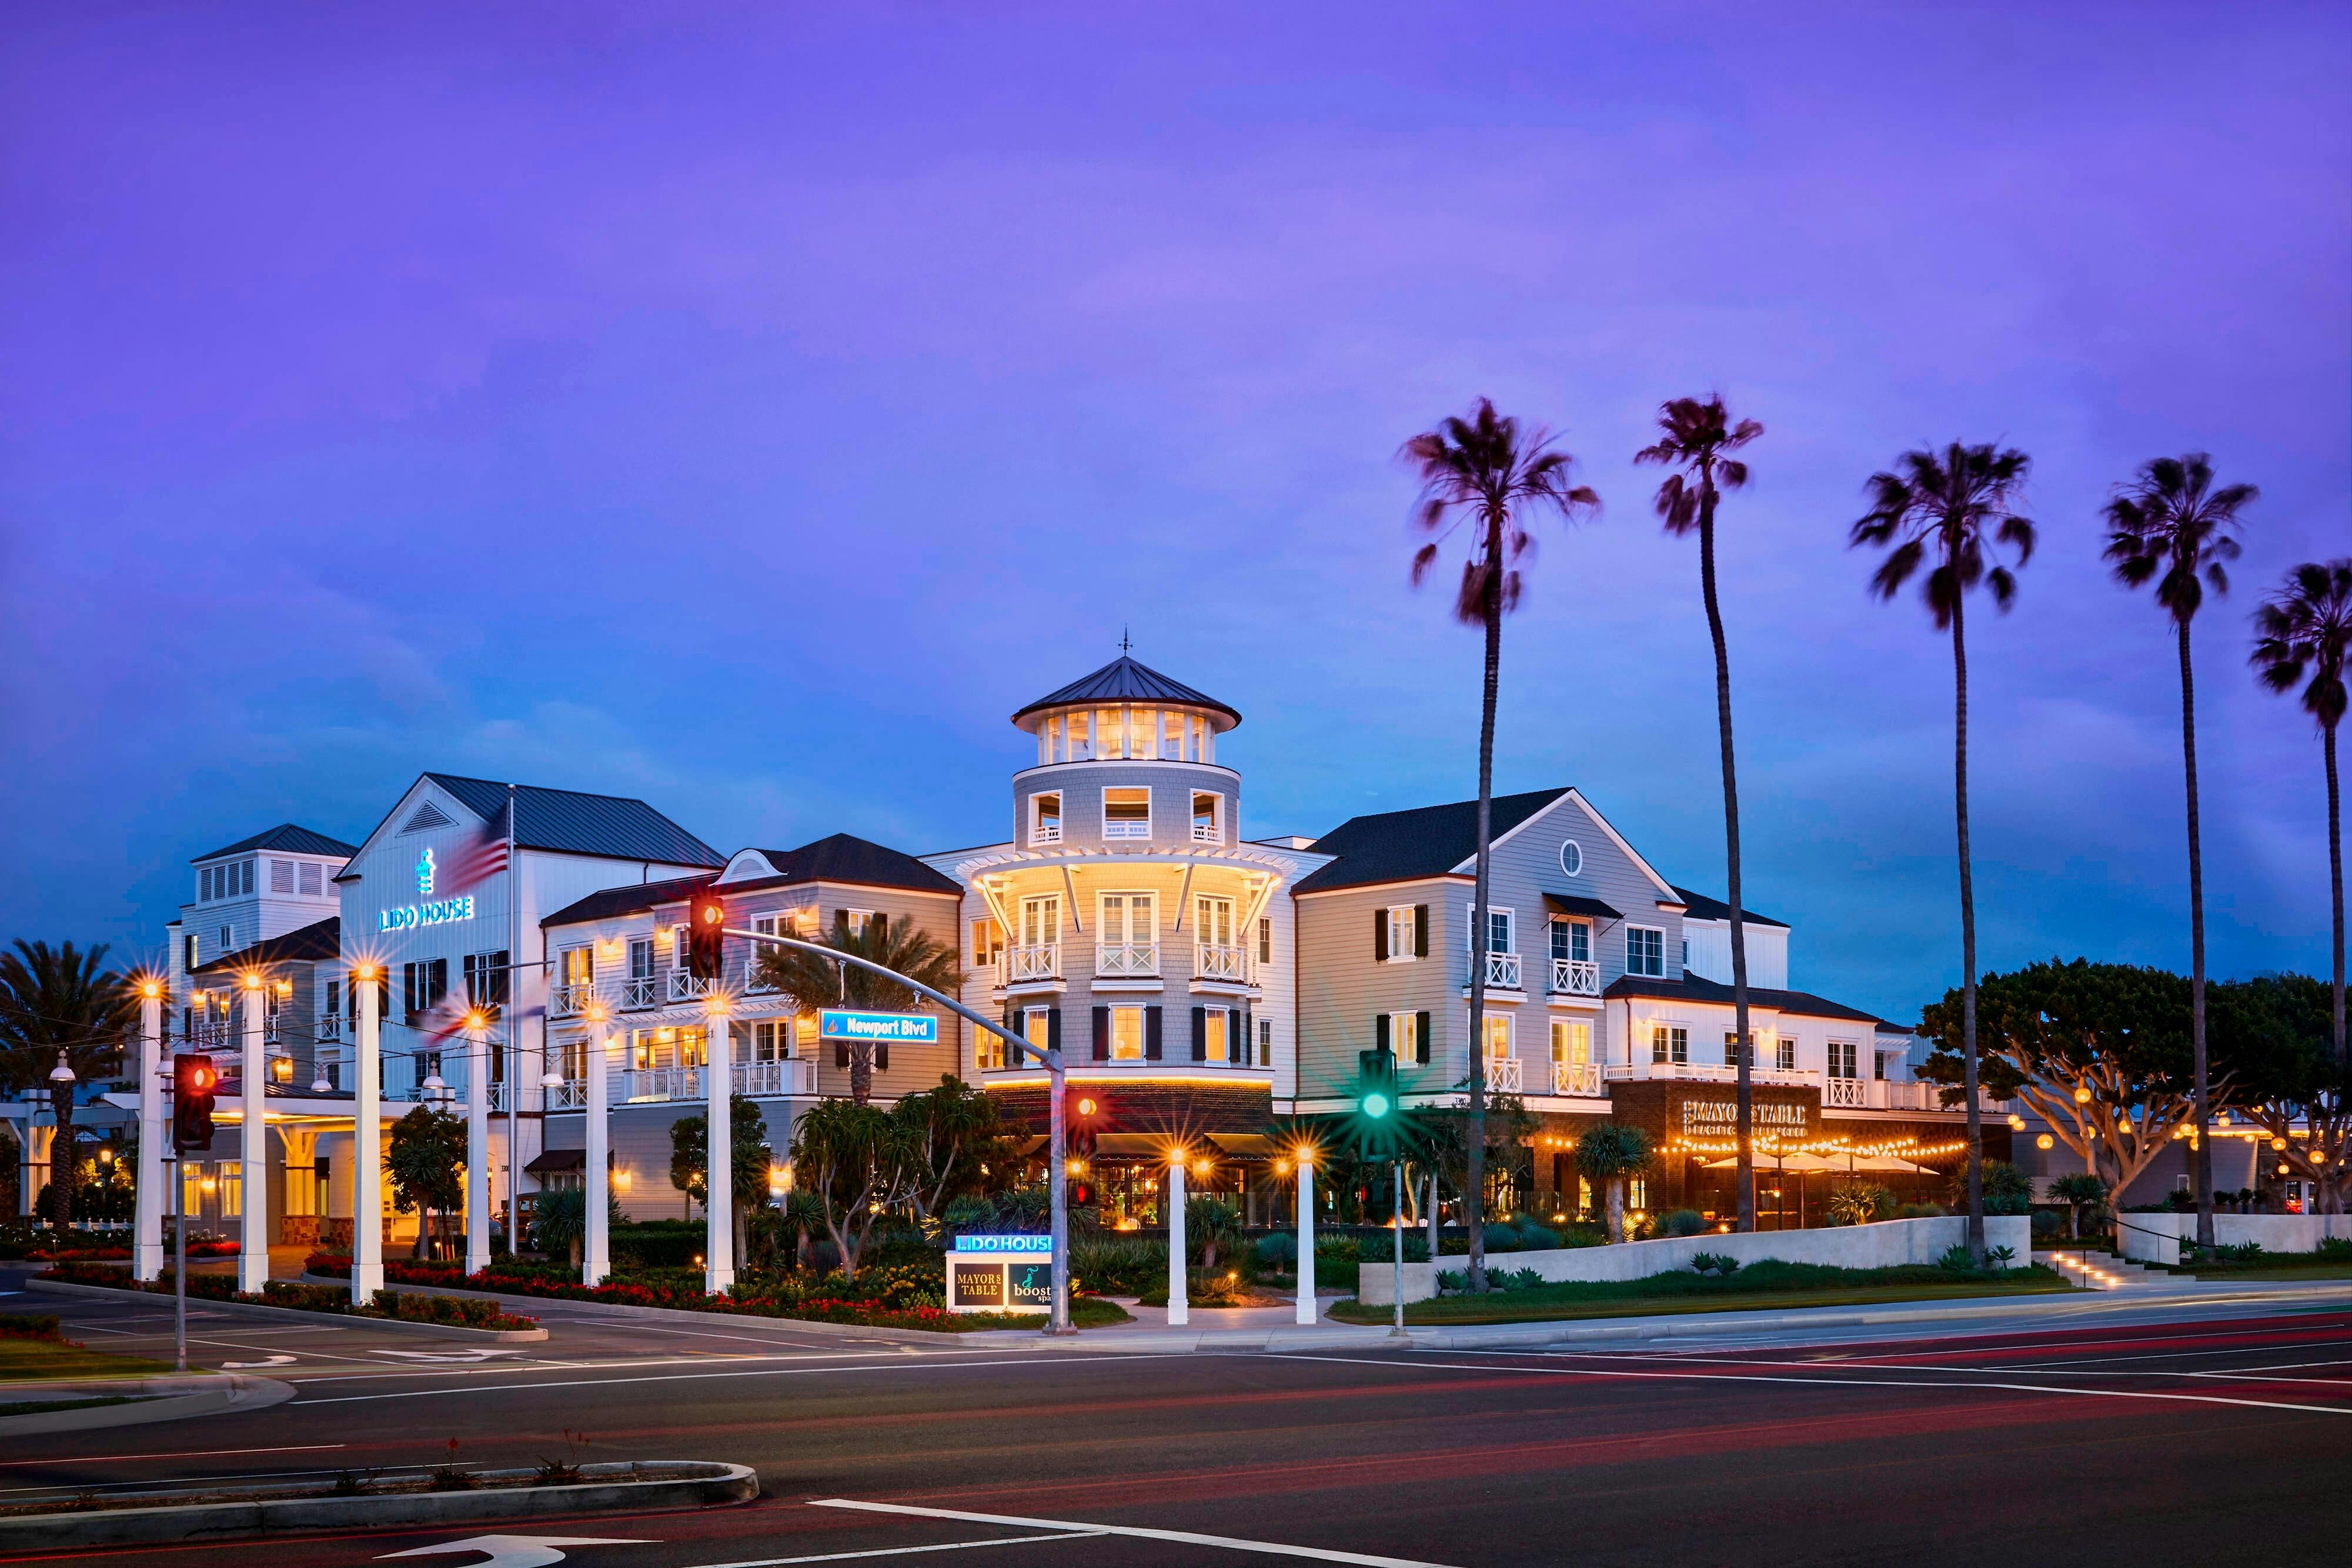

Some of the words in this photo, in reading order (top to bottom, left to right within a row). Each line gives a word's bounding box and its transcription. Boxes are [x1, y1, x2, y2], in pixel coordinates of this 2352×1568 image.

[378, 908, 415, 931] LIDO
[419, 898, 472, 925] HOUSE
[847, 1017, 898, 1037] Newport
[901, 1020, 927, 1036] Blvd
[1693, 1102, 1758, 1122] MAYOS
[1758, 1104, 1807, 1124] TABLE
[957, 1236, 998, 1251] LIDO
[961, 1285, 997, 1295] TABLE
[1014, 1284, 1051, 1296] boost
